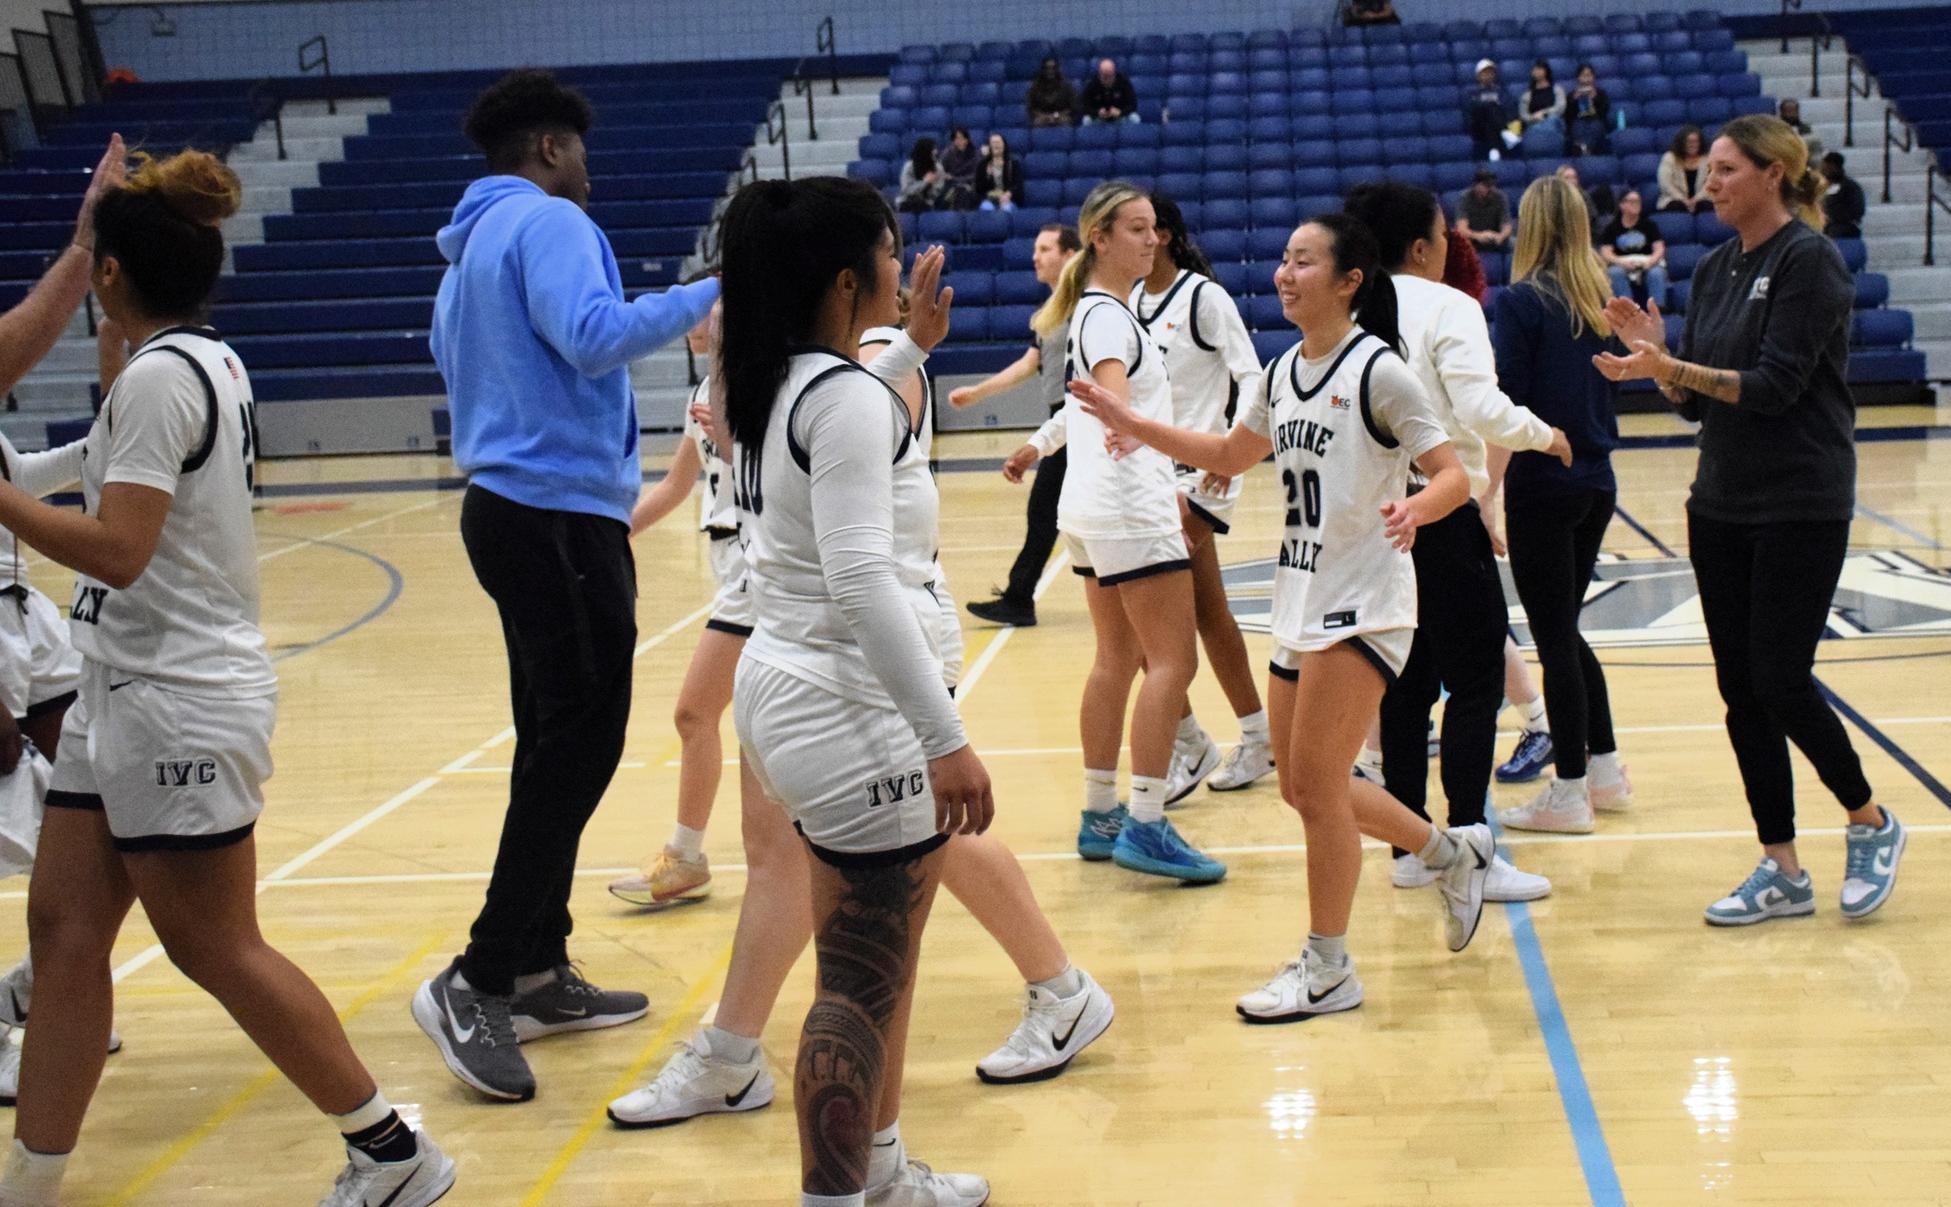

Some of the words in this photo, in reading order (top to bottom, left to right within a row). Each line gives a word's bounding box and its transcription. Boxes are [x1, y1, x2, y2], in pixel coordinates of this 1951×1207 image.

[1275, 419, 1334, 458] IRVINE
[1282, 468, 1321, 528] 20
[155, 759, 216, 786] IVC
[865, 769, 924, 807] IVC
